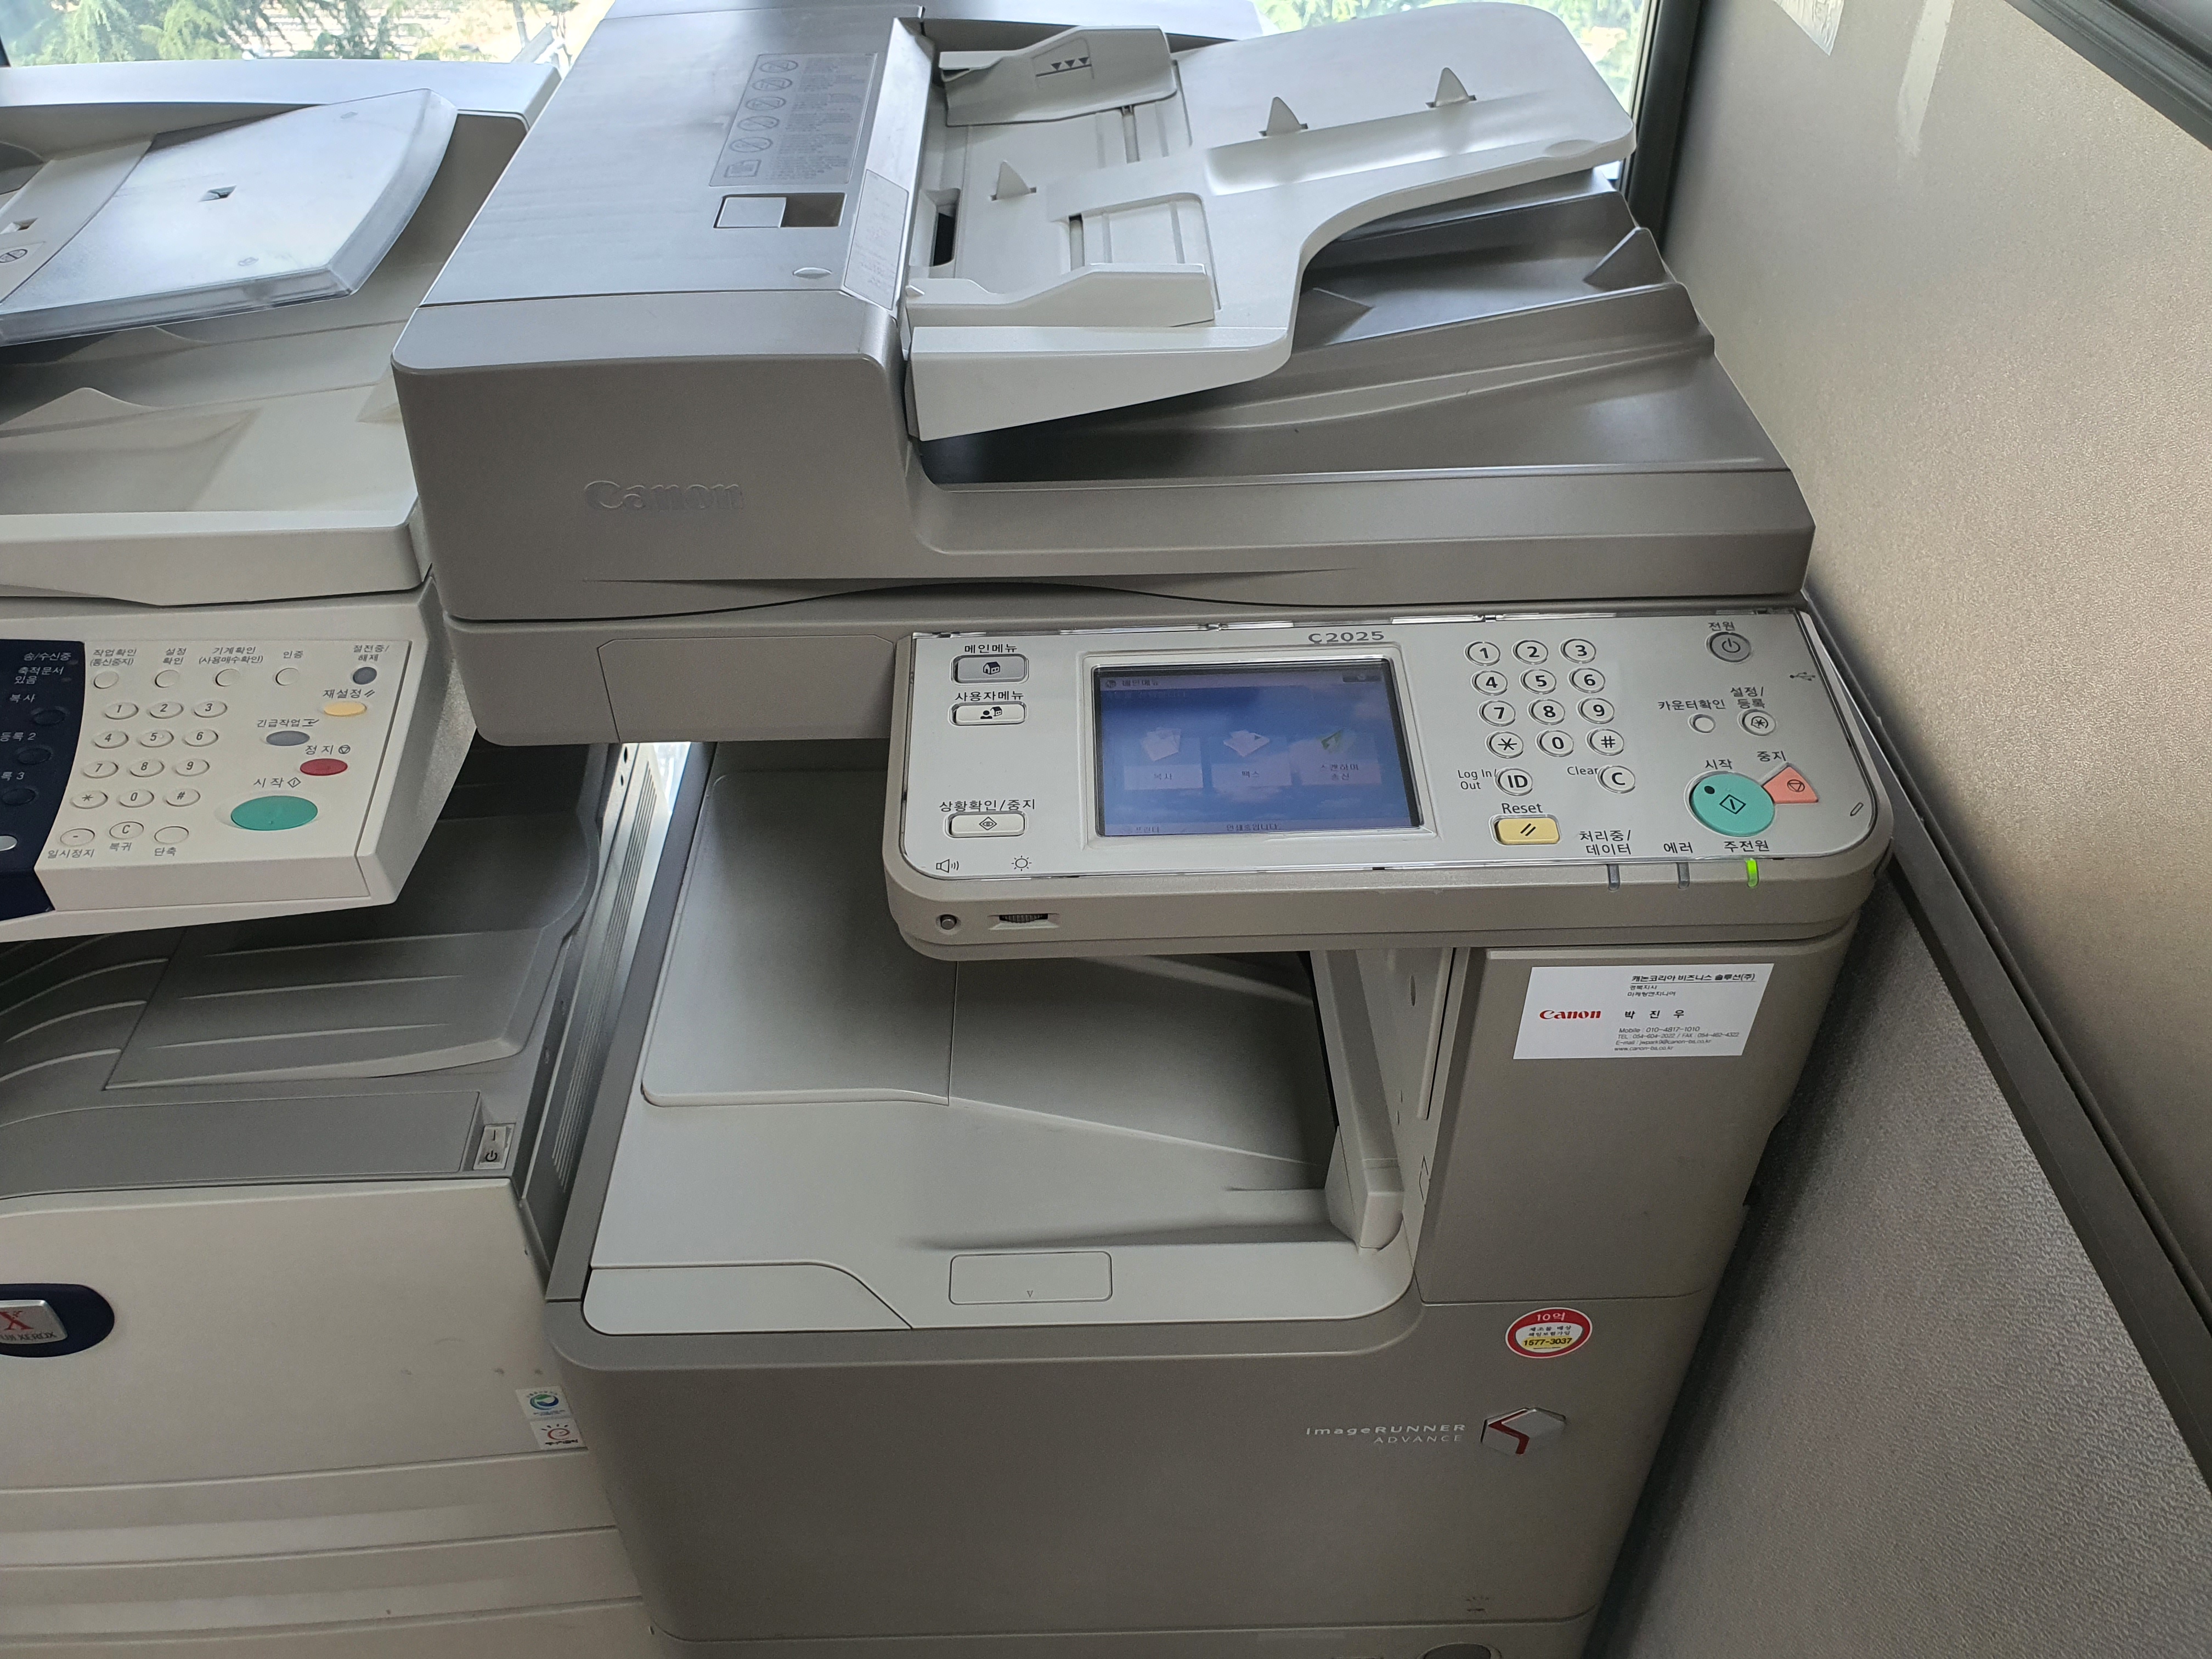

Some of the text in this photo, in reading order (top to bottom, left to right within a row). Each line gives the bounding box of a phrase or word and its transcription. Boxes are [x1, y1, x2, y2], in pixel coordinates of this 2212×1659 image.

[584, 480, 743, 511] Canon
[1708, 622, 1735, 632] 전원
[1308, 630, 1385, 644] C2025
[93, 648, 137, 657] 작업확인
[212, 646, 256, 655] 기계확인
[283, 650, 304, 659] 인증
[964, 644, 1018, 654] 메인메뉴
[1480, 645, 1587, 659] 1 2 3
[24, 652, 72, 661] 송/수신중
[1485, 674, 1596, 689] 4 5 6
[323, 689, 363, 698] 재설정
[955, 691, 1024, 702] 사용자메뉴
[1730, 686, 1764, 698] 설정/
[159, 703, 167, 713] 2
[204, 703, 213, 712] 3
[1658, 699, 1726, 711] 카운터확인
[1737, 698, 1765, 709] 등록
[1493, 704, 1605, 719] 7 8 9
[257, 719, 302, 727] 긴급작업
[104, 731, 204, 742] 4 5 6
[1552, 737, 1564, 749] 0
[1757, 751, 1787, 763] 중지
[96, 761, 194, 772] 7 8 9
[1705, 759, 1733, 770] 시작
[16, 772, 25, 780] 3
[1458, 769, 1478, 780] Log
[1567, 766, 1599, 776] Clear
[253, 777, 284, 788] 시작
[1507, 775, 1528, 788] ID
[1611, 772, 1626, 786] C
[1460, 781, 1481, 790] Out
[129, 792, 138, 802] 0
[939, 799, 1035, 812] 상황확인/중지
[1502, 803, 1543, 814] Reset
[122, 825, 131, 834] C
[1579, 829, 1631, 843] 처리중/
[110, 843, 132, 851] 복귀
[1585, 844, 1632, 856] 데이터
[1663, 842, 1694, 854] 에러
[1724, 840, 1770, 853] 주전원
[48, 849, 95, 859] 일시정지
[154, 848, 177, 857] 단축
[1539, 1009, 1601, 1020] Canon
[1537, 1312, 1565, 1321] 10억
[1523, 1338, 1572, 1346] 1577-3037
[1374, 1434, 1463, 1443] ADVANCE
